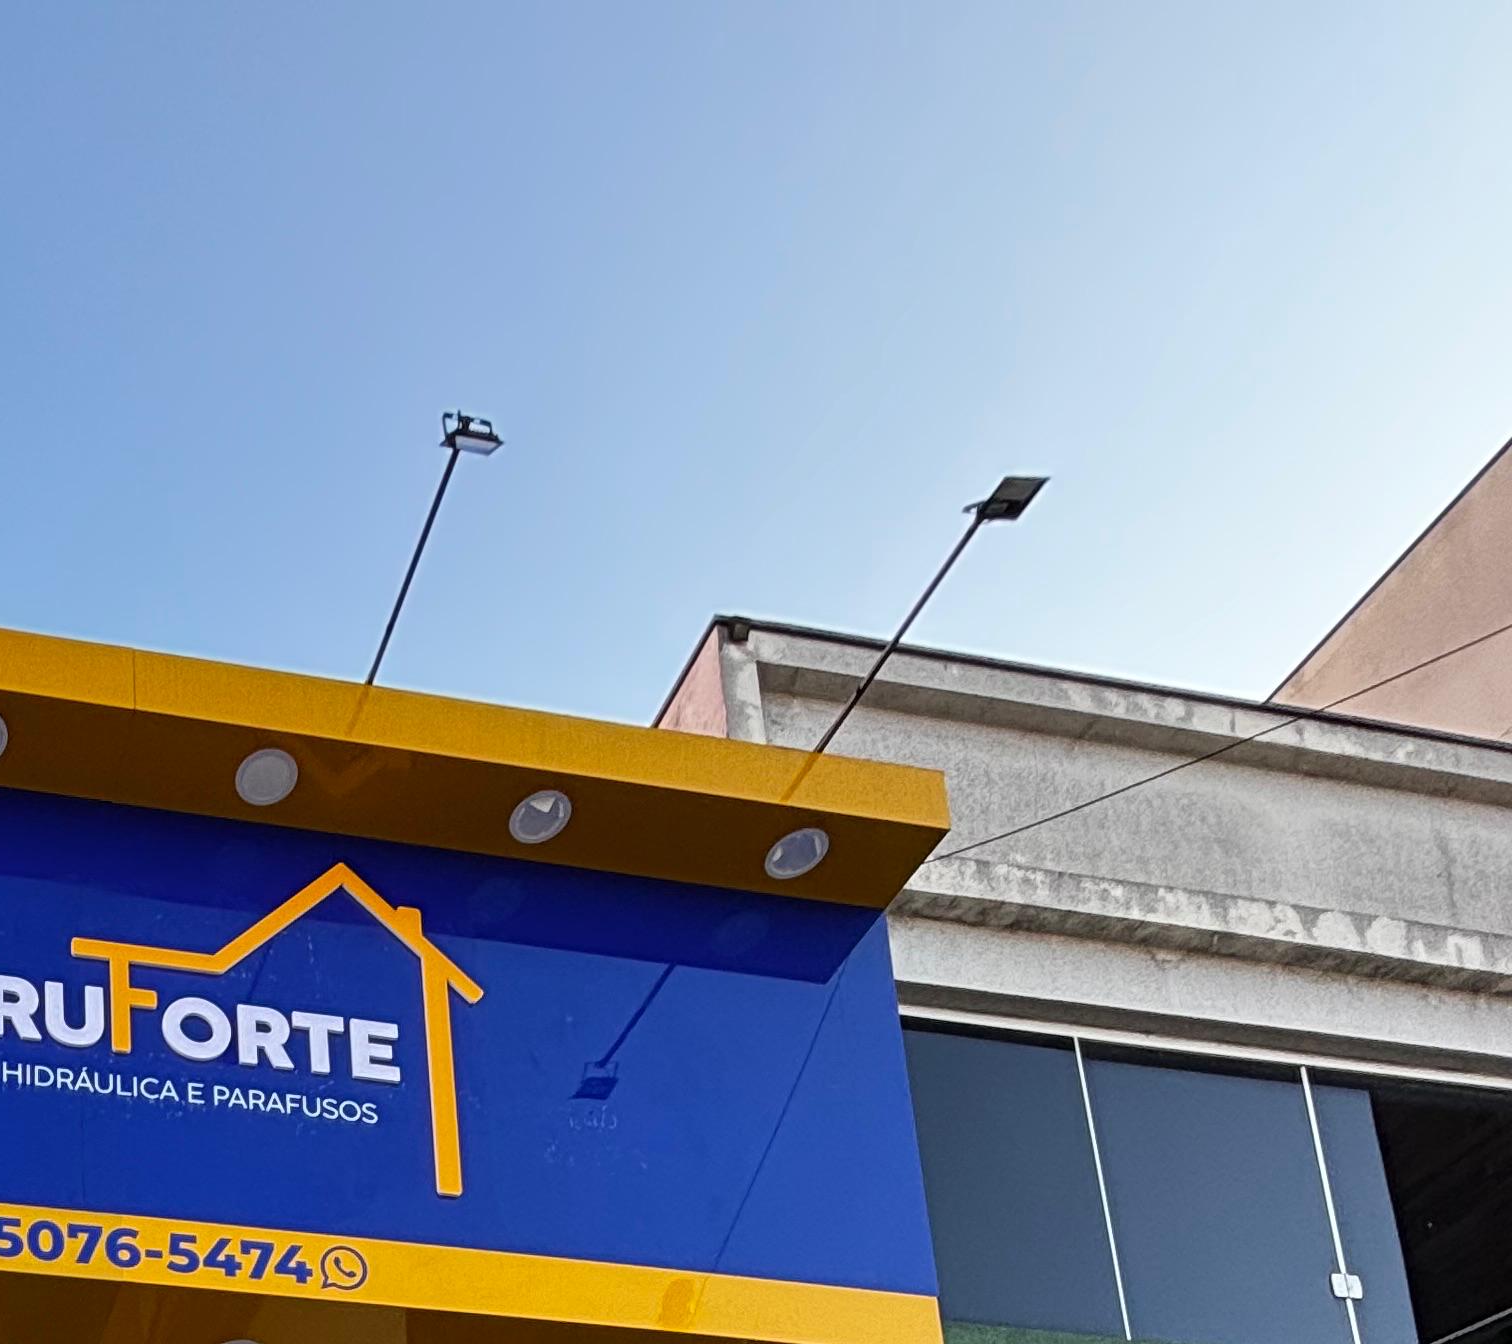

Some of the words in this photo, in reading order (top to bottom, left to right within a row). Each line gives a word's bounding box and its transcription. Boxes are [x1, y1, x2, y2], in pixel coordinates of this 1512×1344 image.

[1, 1060, 181, 1106] HIDRÁULICA
[187, 1082, 206, 1108] E
[213, 1085, 380, 1126] PARAFUSOS
